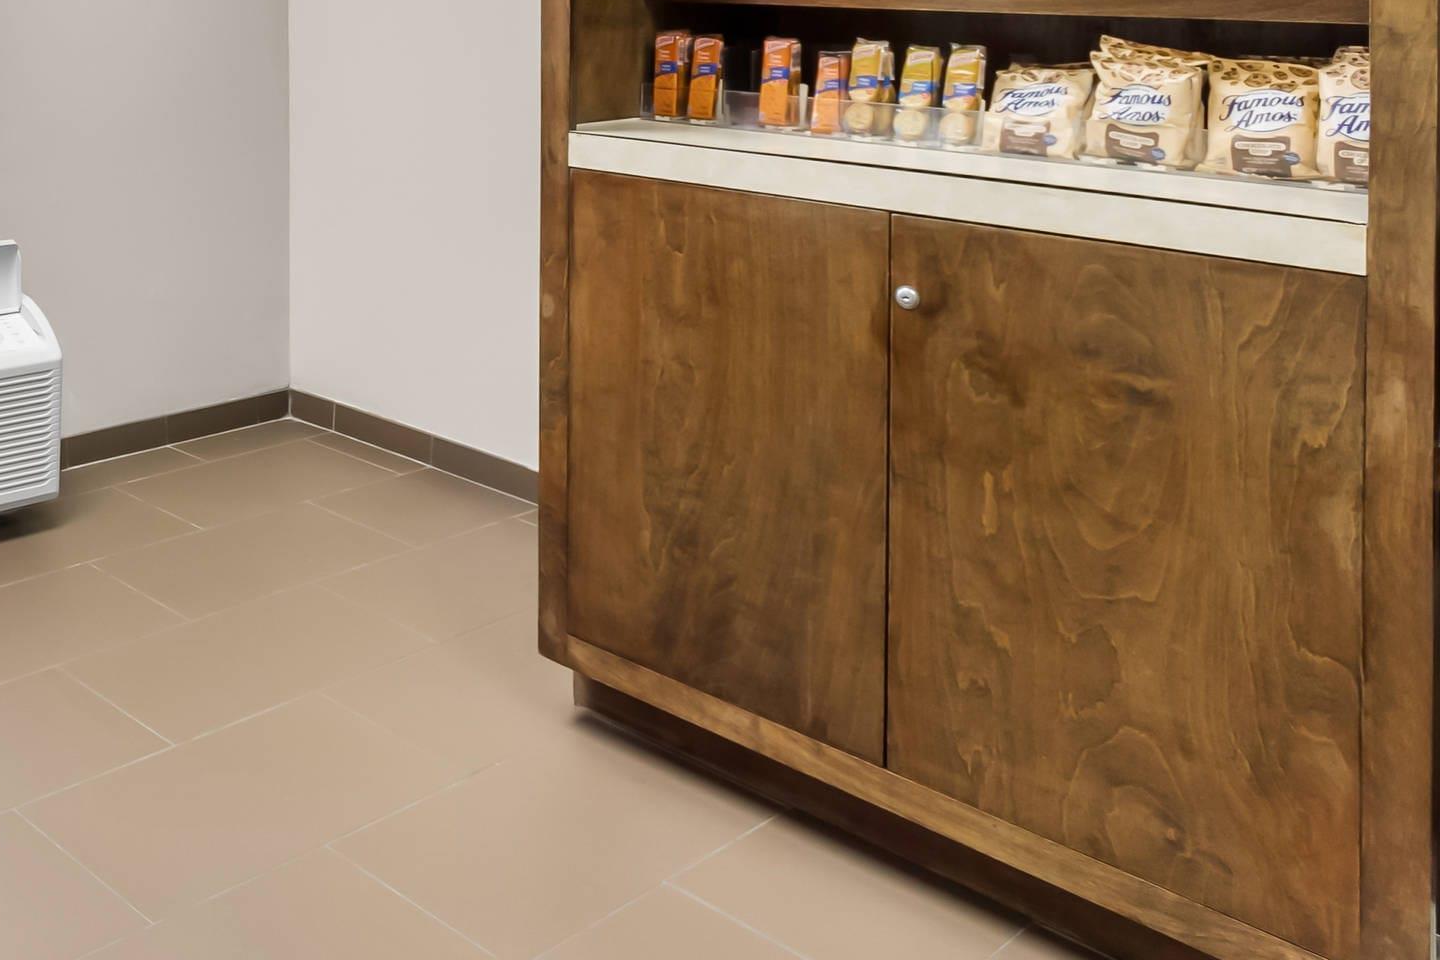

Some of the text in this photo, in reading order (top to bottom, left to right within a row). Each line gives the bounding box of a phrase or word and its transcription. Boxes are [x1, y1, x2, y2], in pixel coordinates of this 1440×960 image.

[994, 85, 1069, 105] Famous
[995, 96, 1059, 113] Amos
[1100, 87, 1172, 106] Famous
[1218, 94, 1306, 122] Famous
[1224, 109, 1298, 133] Amos
